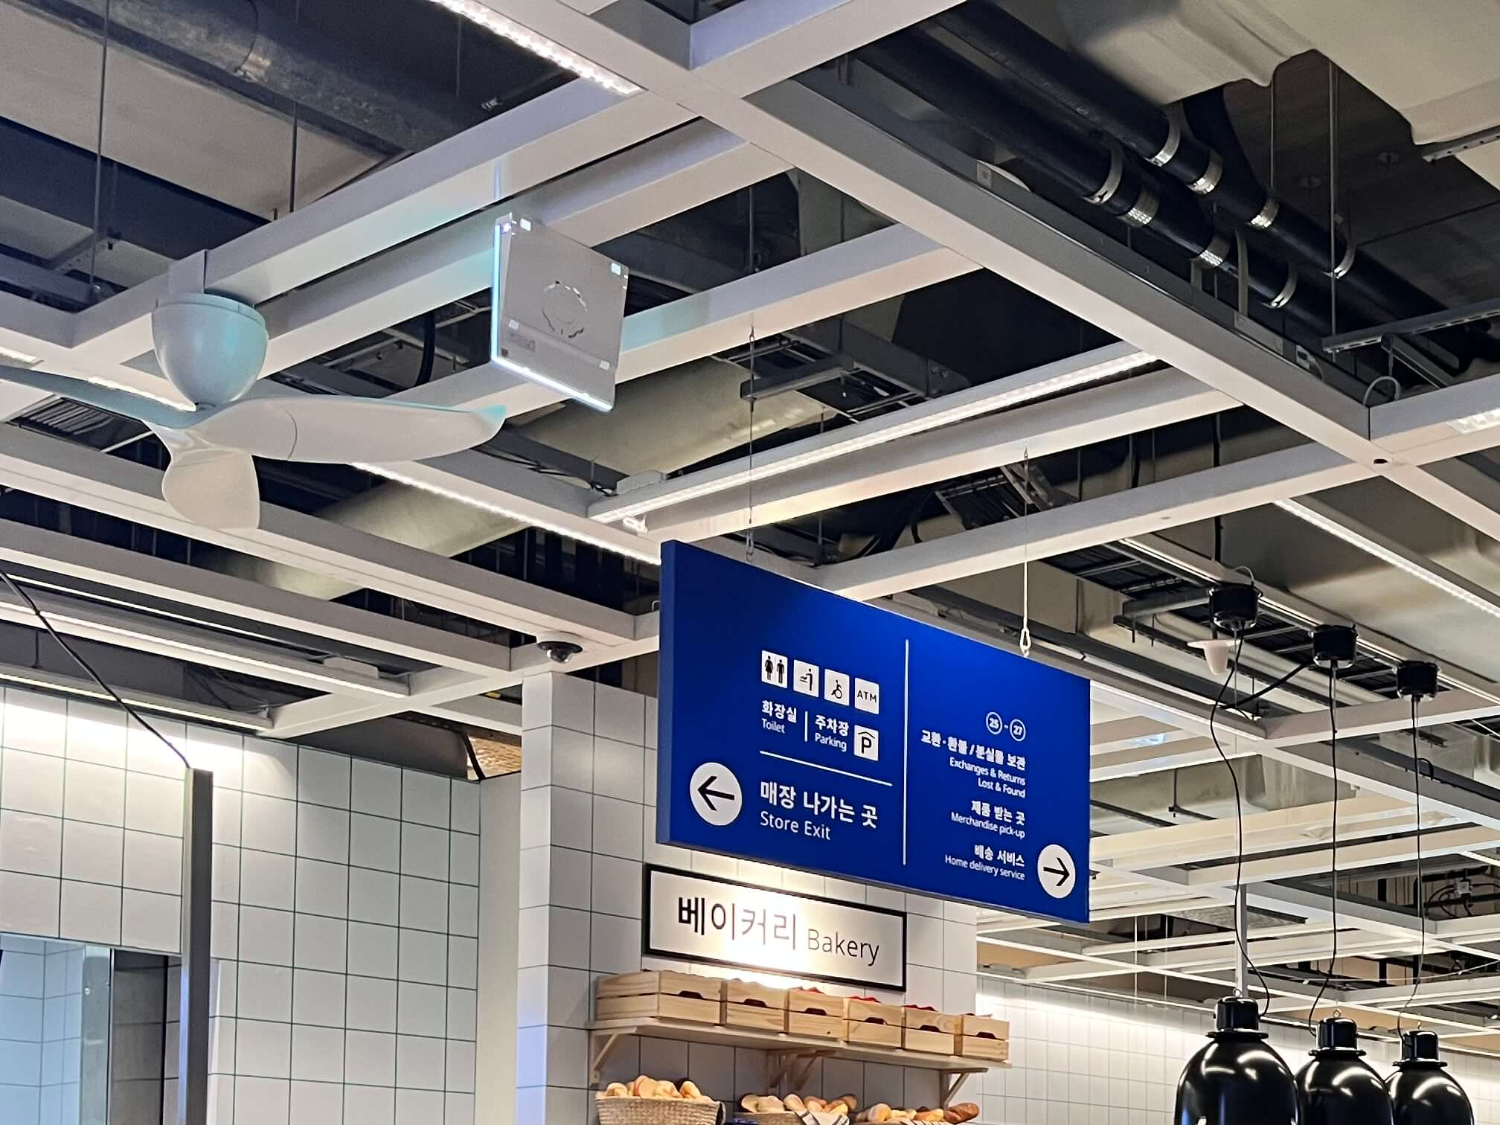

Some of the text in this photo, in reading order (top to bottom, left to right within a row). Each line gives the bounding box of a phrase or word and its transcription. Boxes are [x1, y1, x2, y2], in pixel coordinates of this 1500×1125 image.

[857, 689, 877, 703] ATM
[761, 700, 797, 723] 화장실
[761, 718, 785, 734] Toilet
[815, 714, 849, 737] 주차장
[814, 733, 847, 752] Parking
[949, 757, 1026, 786] Exchanges & Returns
[978, 778, 1026, 798] Lost & Found
[760, 781, 878, 829] 매장 나가는 곳
[971, 800, 1026, 826] 제품 받는 곳
[760, 811, 831, 840] Store Exit
[951, 812, 1026, 840] Merchandise pick-up
[945, 854, 1025, 881] Home delivery service
[974, 844, 1025, 867] 배송 서비스
[678, 897, 796, 950] 베이커리
[807, 928, 880, 967] Bakery
